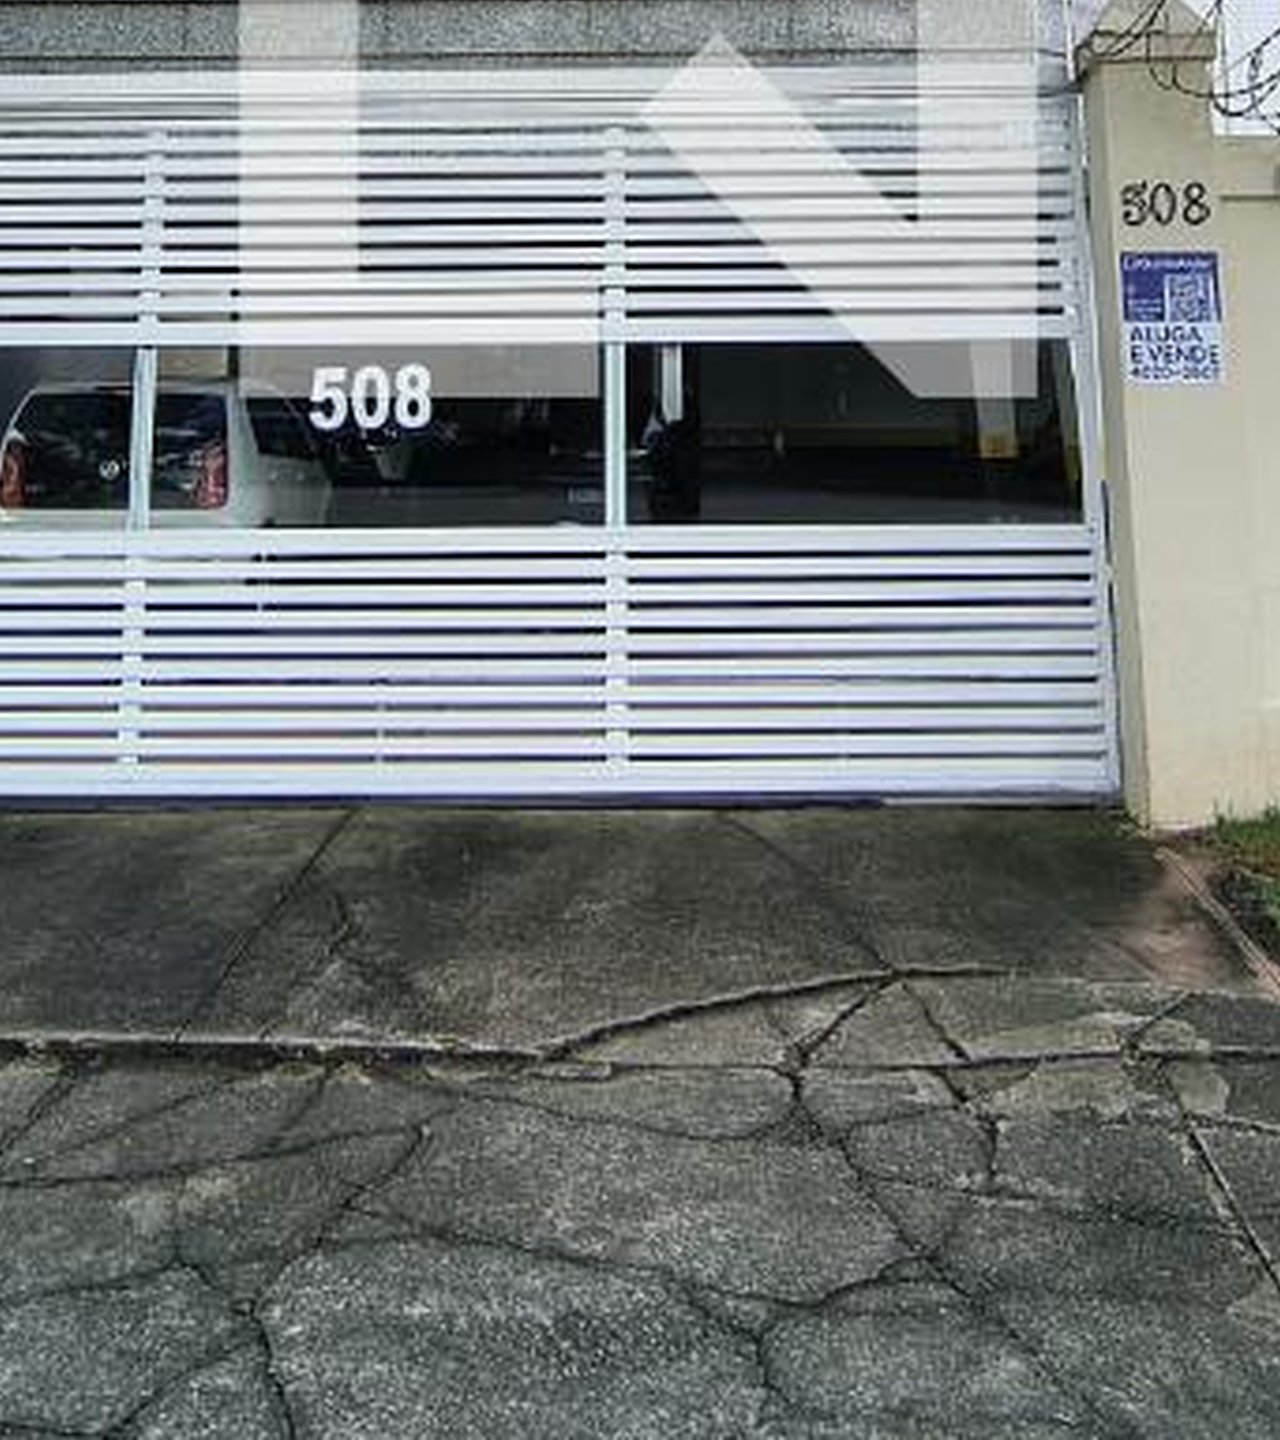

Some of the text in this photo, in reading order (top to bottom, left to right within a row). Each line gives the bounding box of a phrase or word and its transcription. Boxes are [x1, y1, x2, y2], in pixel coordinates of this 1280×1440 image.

[1130, 325, 1203, 342] ALUGA
[1130, 344, 1219, 364] E VENDE
[309, 364, 431, 429] 508
